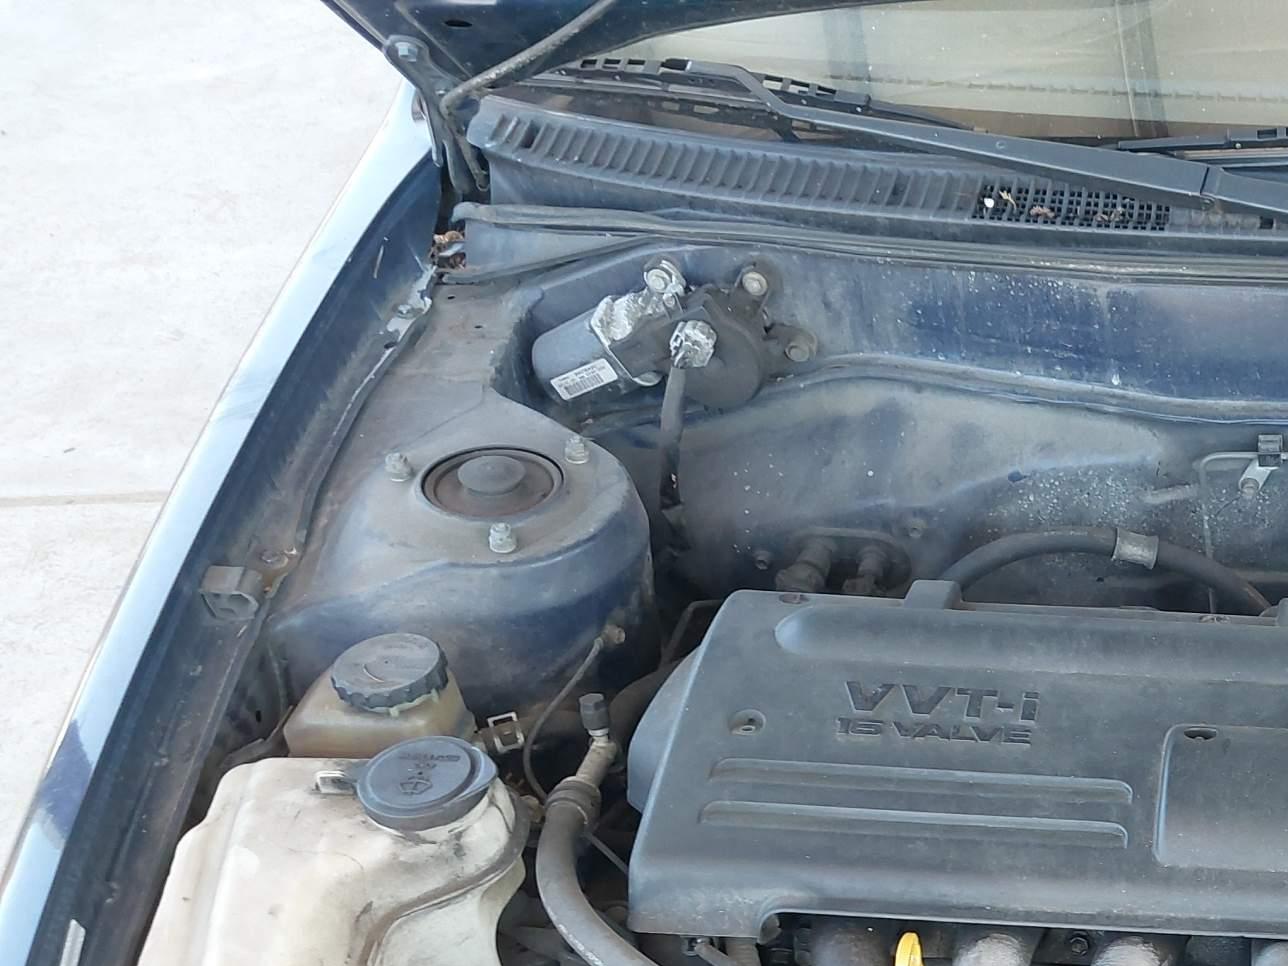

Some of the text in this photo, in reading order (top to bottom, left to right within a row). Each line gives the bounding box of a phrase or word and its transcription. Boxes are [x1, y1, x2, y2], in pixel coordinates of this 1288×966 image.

[845, 681, 1040, 722] VVT-i
[836, 717, 1033, 746] 16 VALVE
